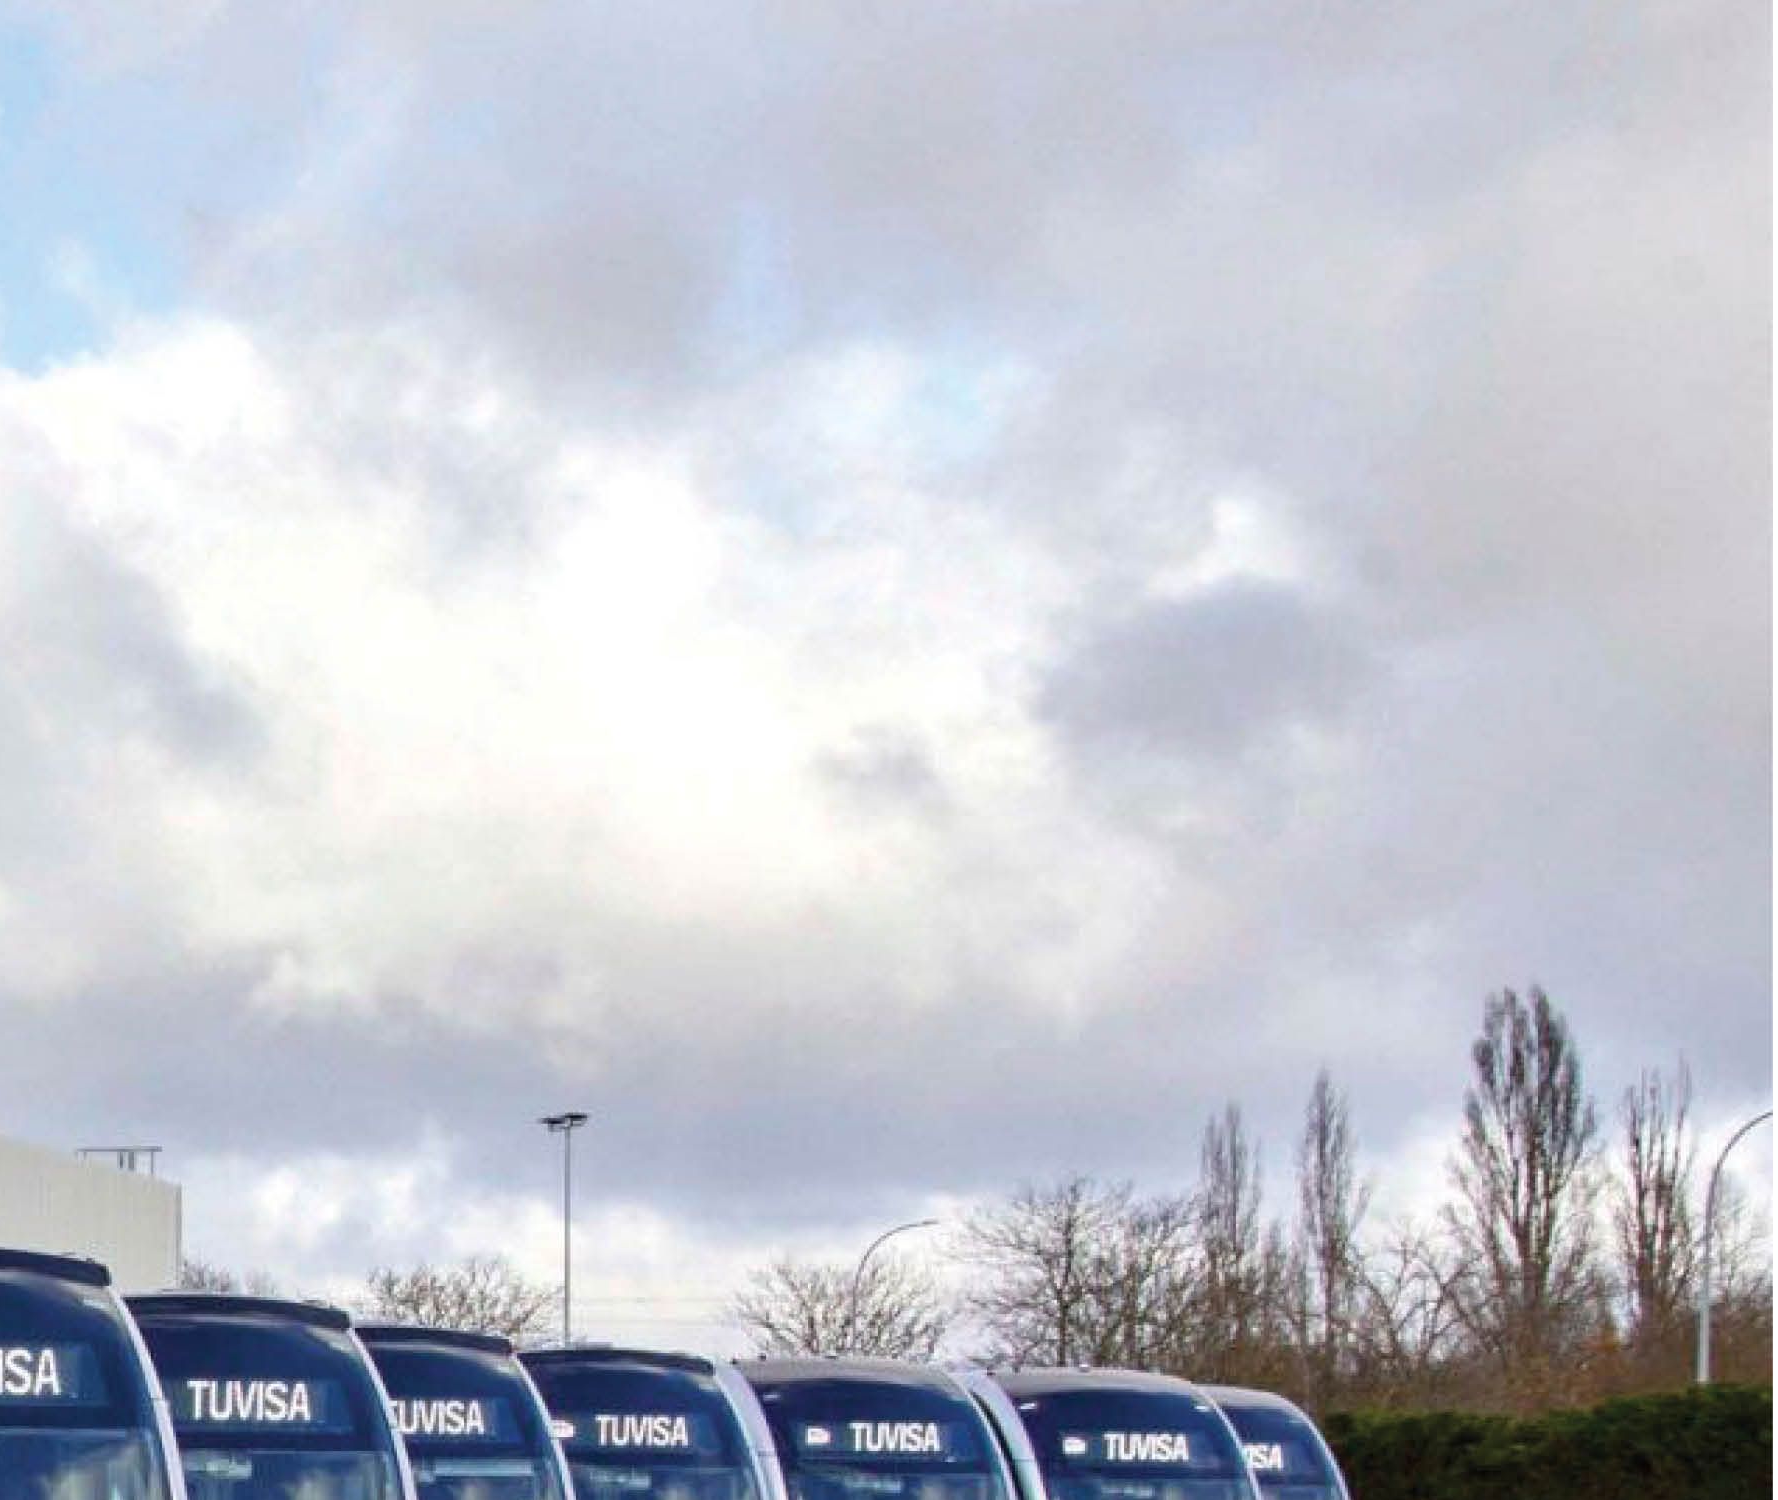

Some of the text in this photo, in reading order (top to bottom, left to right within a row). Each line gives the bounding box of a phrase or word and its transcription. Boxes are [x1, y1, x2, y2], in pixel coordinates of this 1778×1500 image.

[187, 1379, 311, 1421] TUVISA
[595, 1414, 689, 1447] TUVISA
[850, 1422, 941, 1452] TUVISA
[1103, 1432, 1190, 1463] TUVISA
